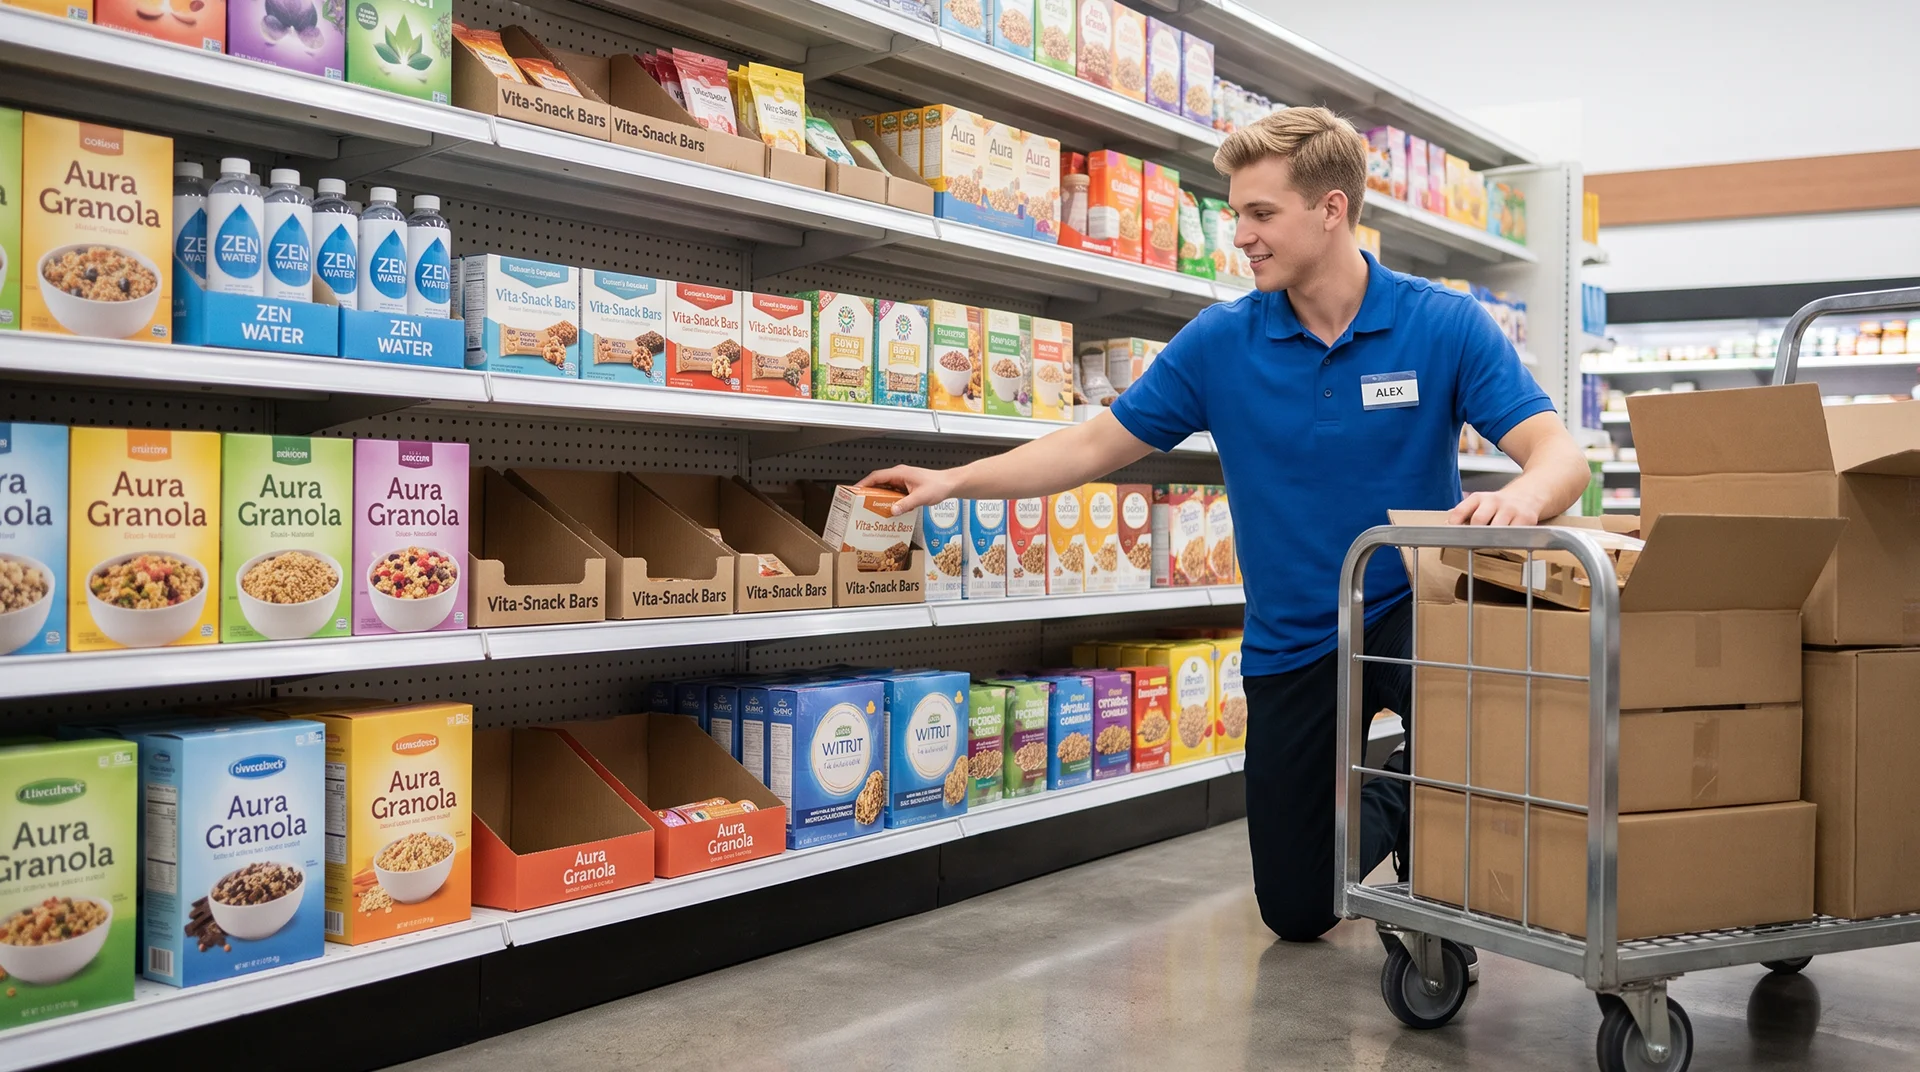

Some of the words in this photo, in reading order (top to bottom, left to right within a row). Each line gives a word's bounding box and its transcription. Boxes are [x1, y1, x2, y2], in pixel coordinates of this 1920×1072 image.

[501, 88, 574, 120] Vita-Snack
[577, 107, 606, 128] Bars
[614, 117, 677, 146] Vita-Snack
[679, 132, 705, 152] Bars
[951, 124, 976, 146] Aura
[990, 138, 1013, 159] Aura
[1025, 148, 1051, 168] Aura
[64, 159, 137, 195] Aura
[39, 187, 161, 228] Granola
[183, 236, 206, 253] ZE
[221, 234, 259, 254] ZEN
[275, 243, 309, 262] ZEN
[221, 252, 257, 264] WATER
[275, 260, 308, 272] WATER
[323, 252, 356, 270] ZEN
[377, 257, 407, 275] ZEN
[323, 268, 355, 279] WATER
[377, 273, 406, 284] WATER
[421, 263, 450, 281] ZEN
[554, 295, 576, 311] Bars
[256, 304, 292, 323] ZEN
[642, 306, 662, 321] Bars
[720, 316, 739, 330] Bars
[241, 322, 304, 345] WATER
[390, 319, 422, 338] ZEN
[792, 325, 809, 338] Bars
[377, 336, 433, 357] WATER
[1375, 386, 1404, 398] ALEX
[112, 470, 185, 498] Aura
[259, 474, 322, 499] Aura
[387, 476, 442, 500] Aura
[87, 500, 208, 527] Granola
[238, 501, 342, 526] Granola
[367, 502, 459, 526] Granola
[632, 588, 699, 606] Vita-Snack
[701, 588, 727, 603] Bars
[746, 583, 803, 599] Vita-Snack
[805, 583, 827, 597] Bars
[846, 580, 897, 595] Vita-Snack
[899, 579, 920, 592] Bars
[487, 593, 566, 612] Vita-Snack
[569, 593, 599, 609] Bars
[389, 770, 440, 793] Aura
[227, 795, 288, 820] Aura
[371, 787, 457, 820] Granola
[12, 821, 90, 850] Aura
[205, 814, 307, 849] Granola
[717, 822, 745, 838] Aura
[707, 833, 754, 856] Granola
[574, 849, 606, 867] Aura
[563, 861, 616, 885] Granola
